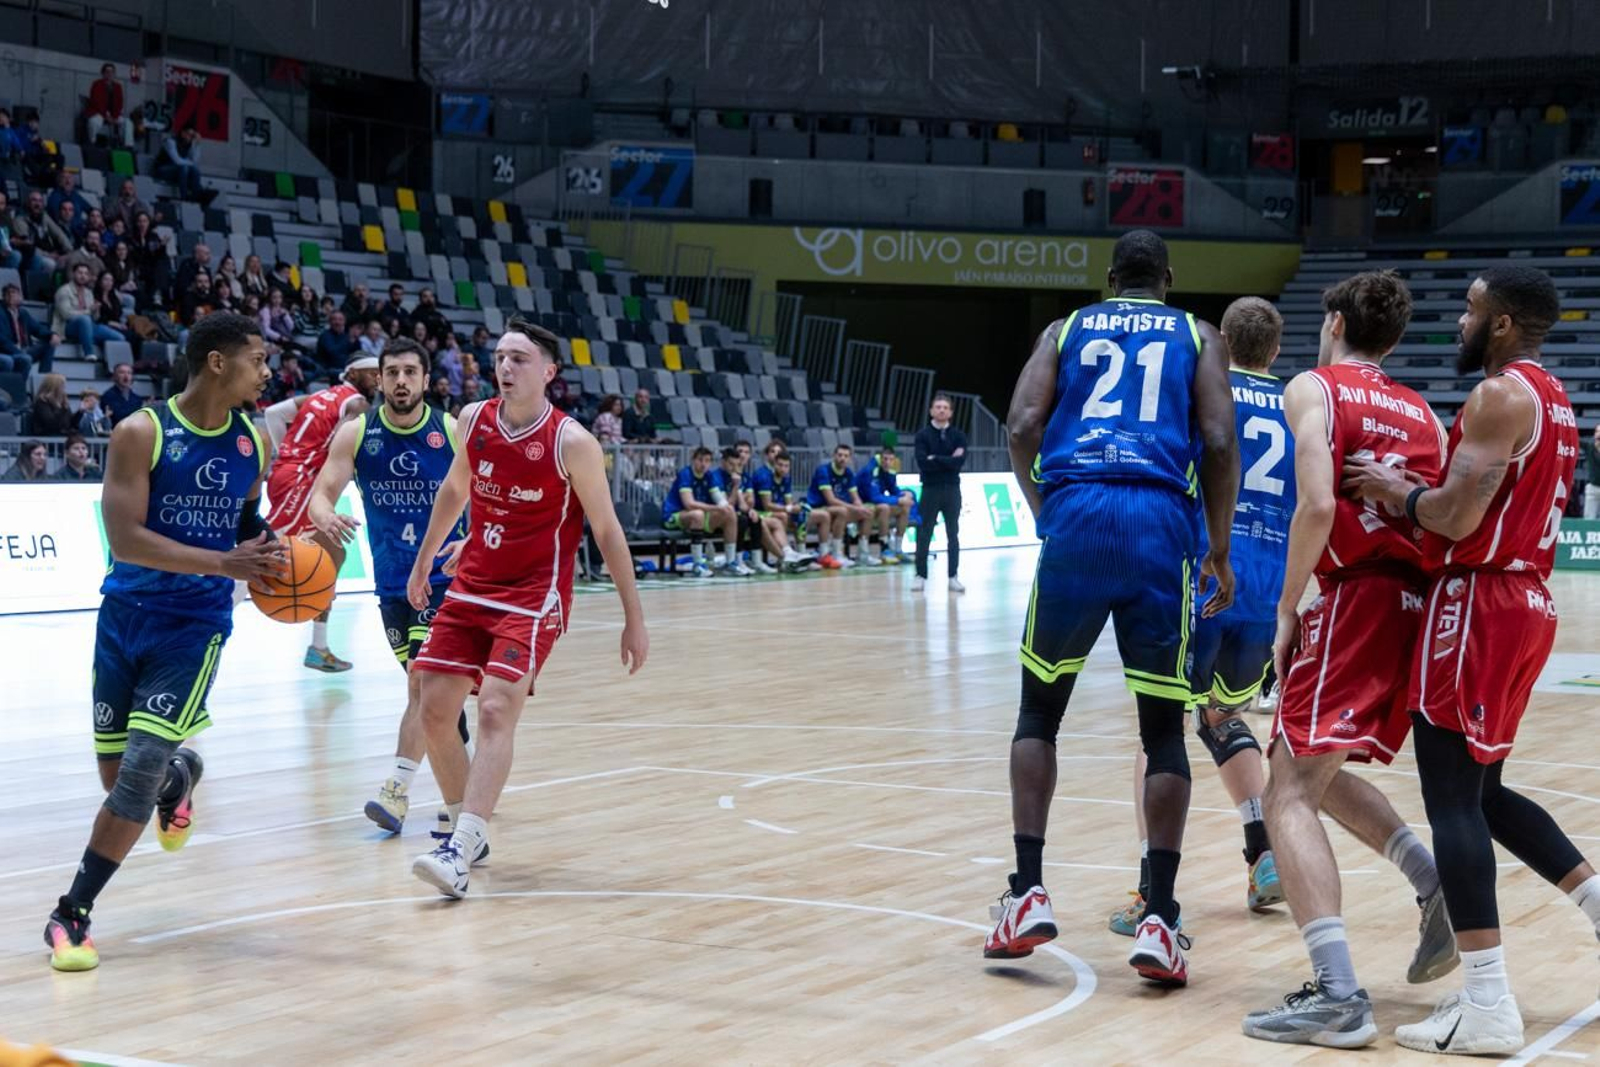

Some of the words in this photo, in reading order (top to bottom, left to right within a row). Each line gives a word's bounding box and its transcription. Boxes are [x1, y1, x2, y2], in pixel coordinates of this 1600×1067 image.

[165, 66, 206, 88] Sector
[1328, 109, 1398, 129] Salida
[1398, 97, 1429, 125] 12
[609, 147, 664, 163] Sector
[493, 155, 515, 183] 26
[611, 149, 694, 208] 27
[1107, 169, 1156, 184] Sector
[872, 230, 962, 264] olivo
[975, 239, 1089, 268] arena
[1082, 313, 1178, 334] BAPTISTE
[1080, 338, 1167, 422] 21
[1337, 383, 1367, 406] JAVI
[294, 411, 316, 443] 1
[1362, 417, 1408, 442] Blanca
[1243, 415, 1286, 497] 2
[370, 480, 424, 491] CASTILLO
[162, 494, 232, 509] CASTILLO
[372, 492, 437, 506] GORRAI
[159, 507, 240, 529] GORRAI
[0, 534, 57, 559] EJA
[401, 523, 417, 546] 4
[483, 521, 505, 550] 16
